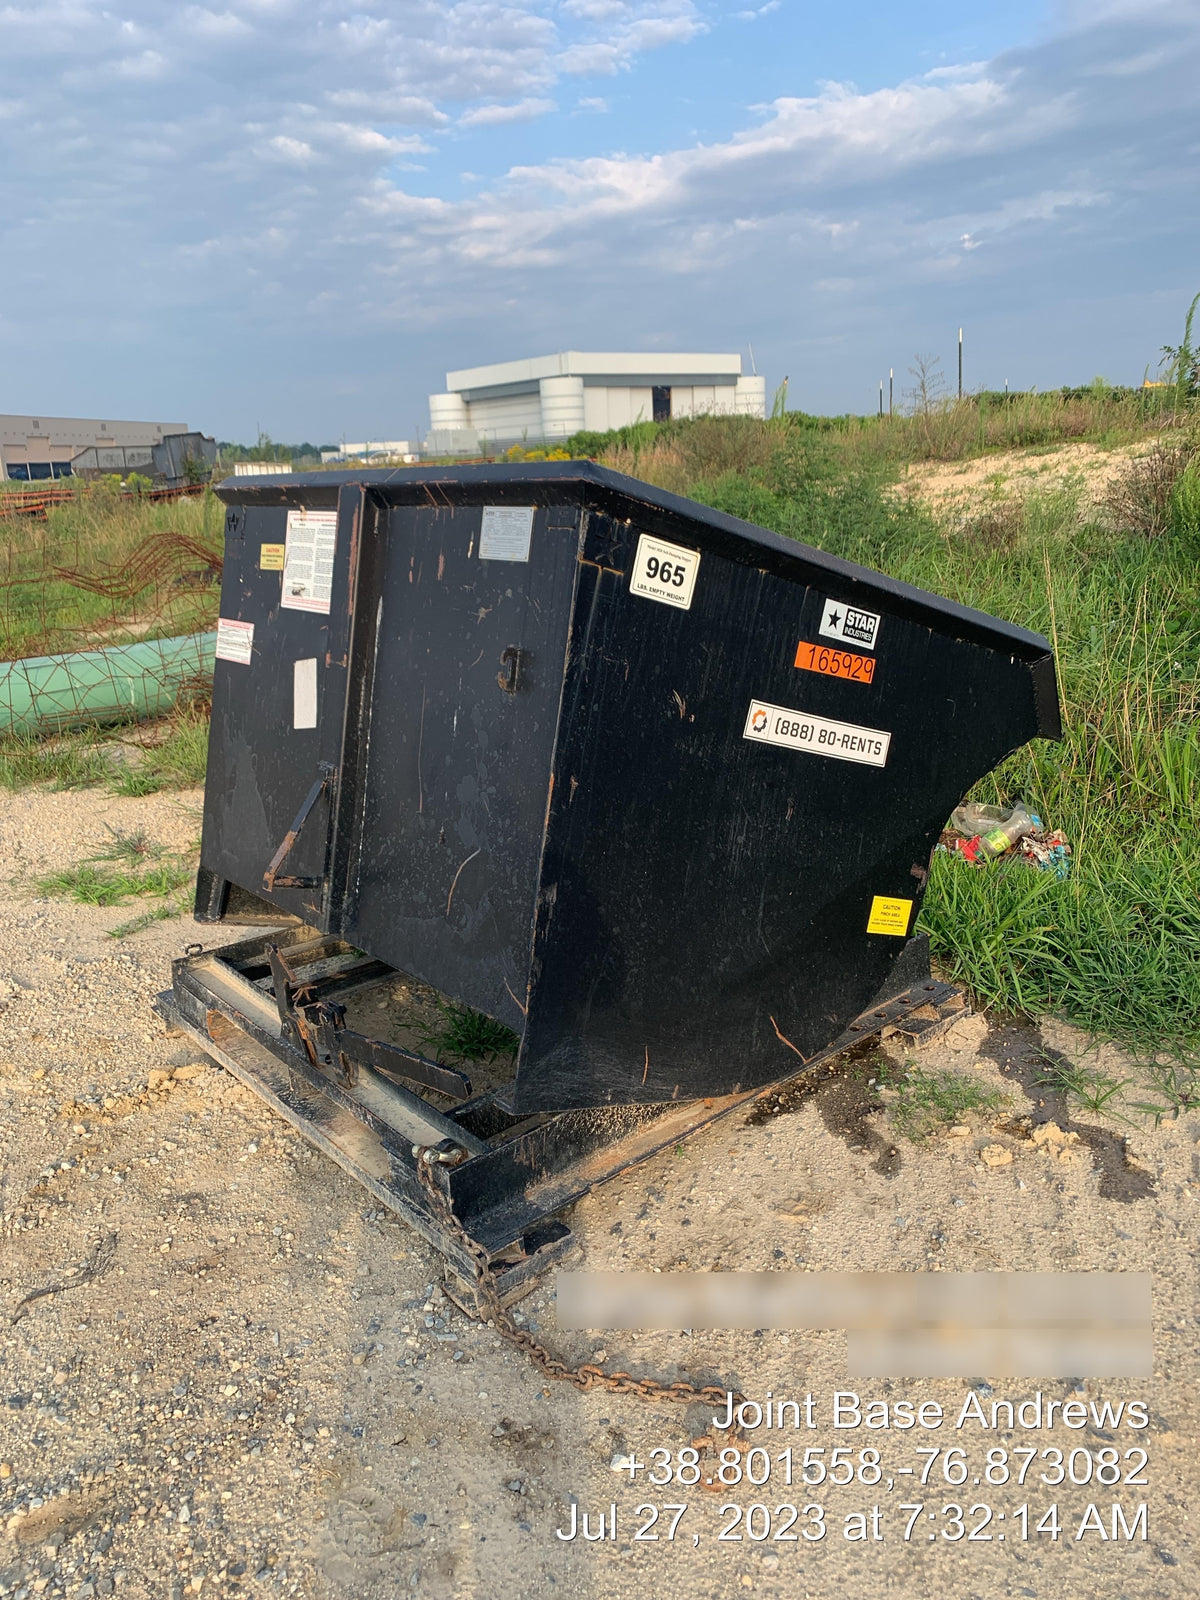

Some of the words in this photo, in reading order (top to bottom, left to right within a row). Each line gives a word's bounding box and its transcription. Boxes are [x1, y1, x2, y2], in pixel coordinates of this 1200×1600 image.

[645, 556, 686, 587] 965
[637, 582, 648, 592] LBS.
[648, 586, 666, 596] EMPTY
[666, 591, 685, 602] WEIGHT
[844, 626, 873, 642] INDUSTRIES
[846, 610, 876, 633] STAR
[808, 645, 874, 682] 165929
[774, 717, 815, 743] (888)
[818, 728, 883, 756] 80-RENTS
